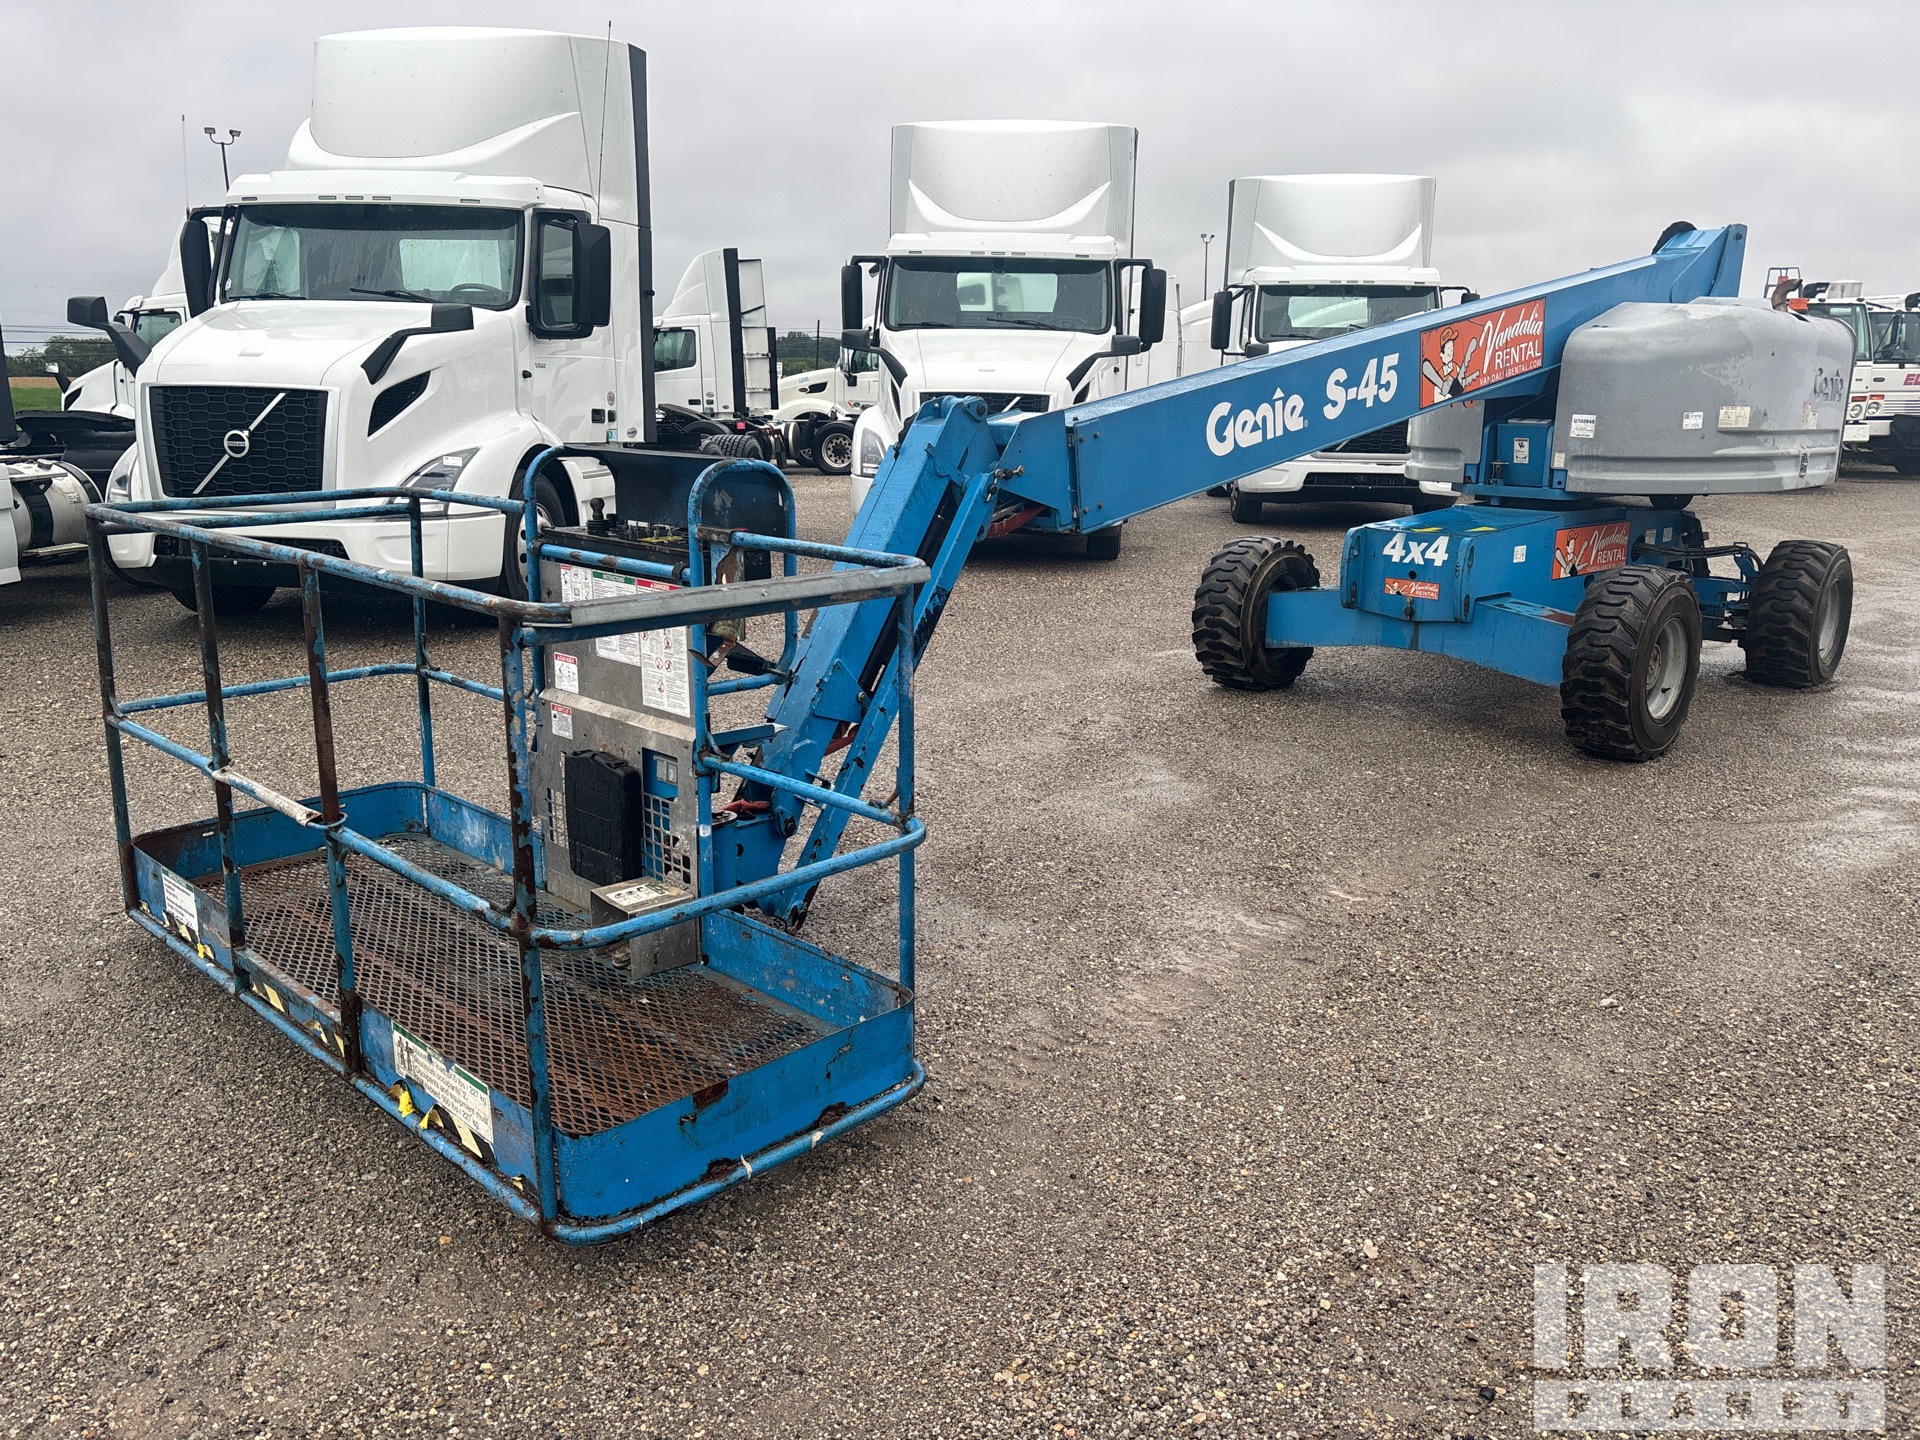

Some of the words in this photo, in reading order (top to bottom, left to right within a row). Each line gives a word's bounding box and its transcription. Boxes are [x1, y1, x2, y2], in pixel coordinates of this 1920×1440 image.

[1479, 303, 1543, 374] Vandalia
[1494, 339, 1541, 370] RENTAL
[1206, 387, 1304, 457] Genie
[1323, 353, 1399, 420] S-45
[1383, 532, 1450, 567] 4x4
[1589, 525, 1629, 565] Vandalia
[1597, 548, 1626, 564] RENTAL
[1415, 590, 1438, 598] RENTAL
